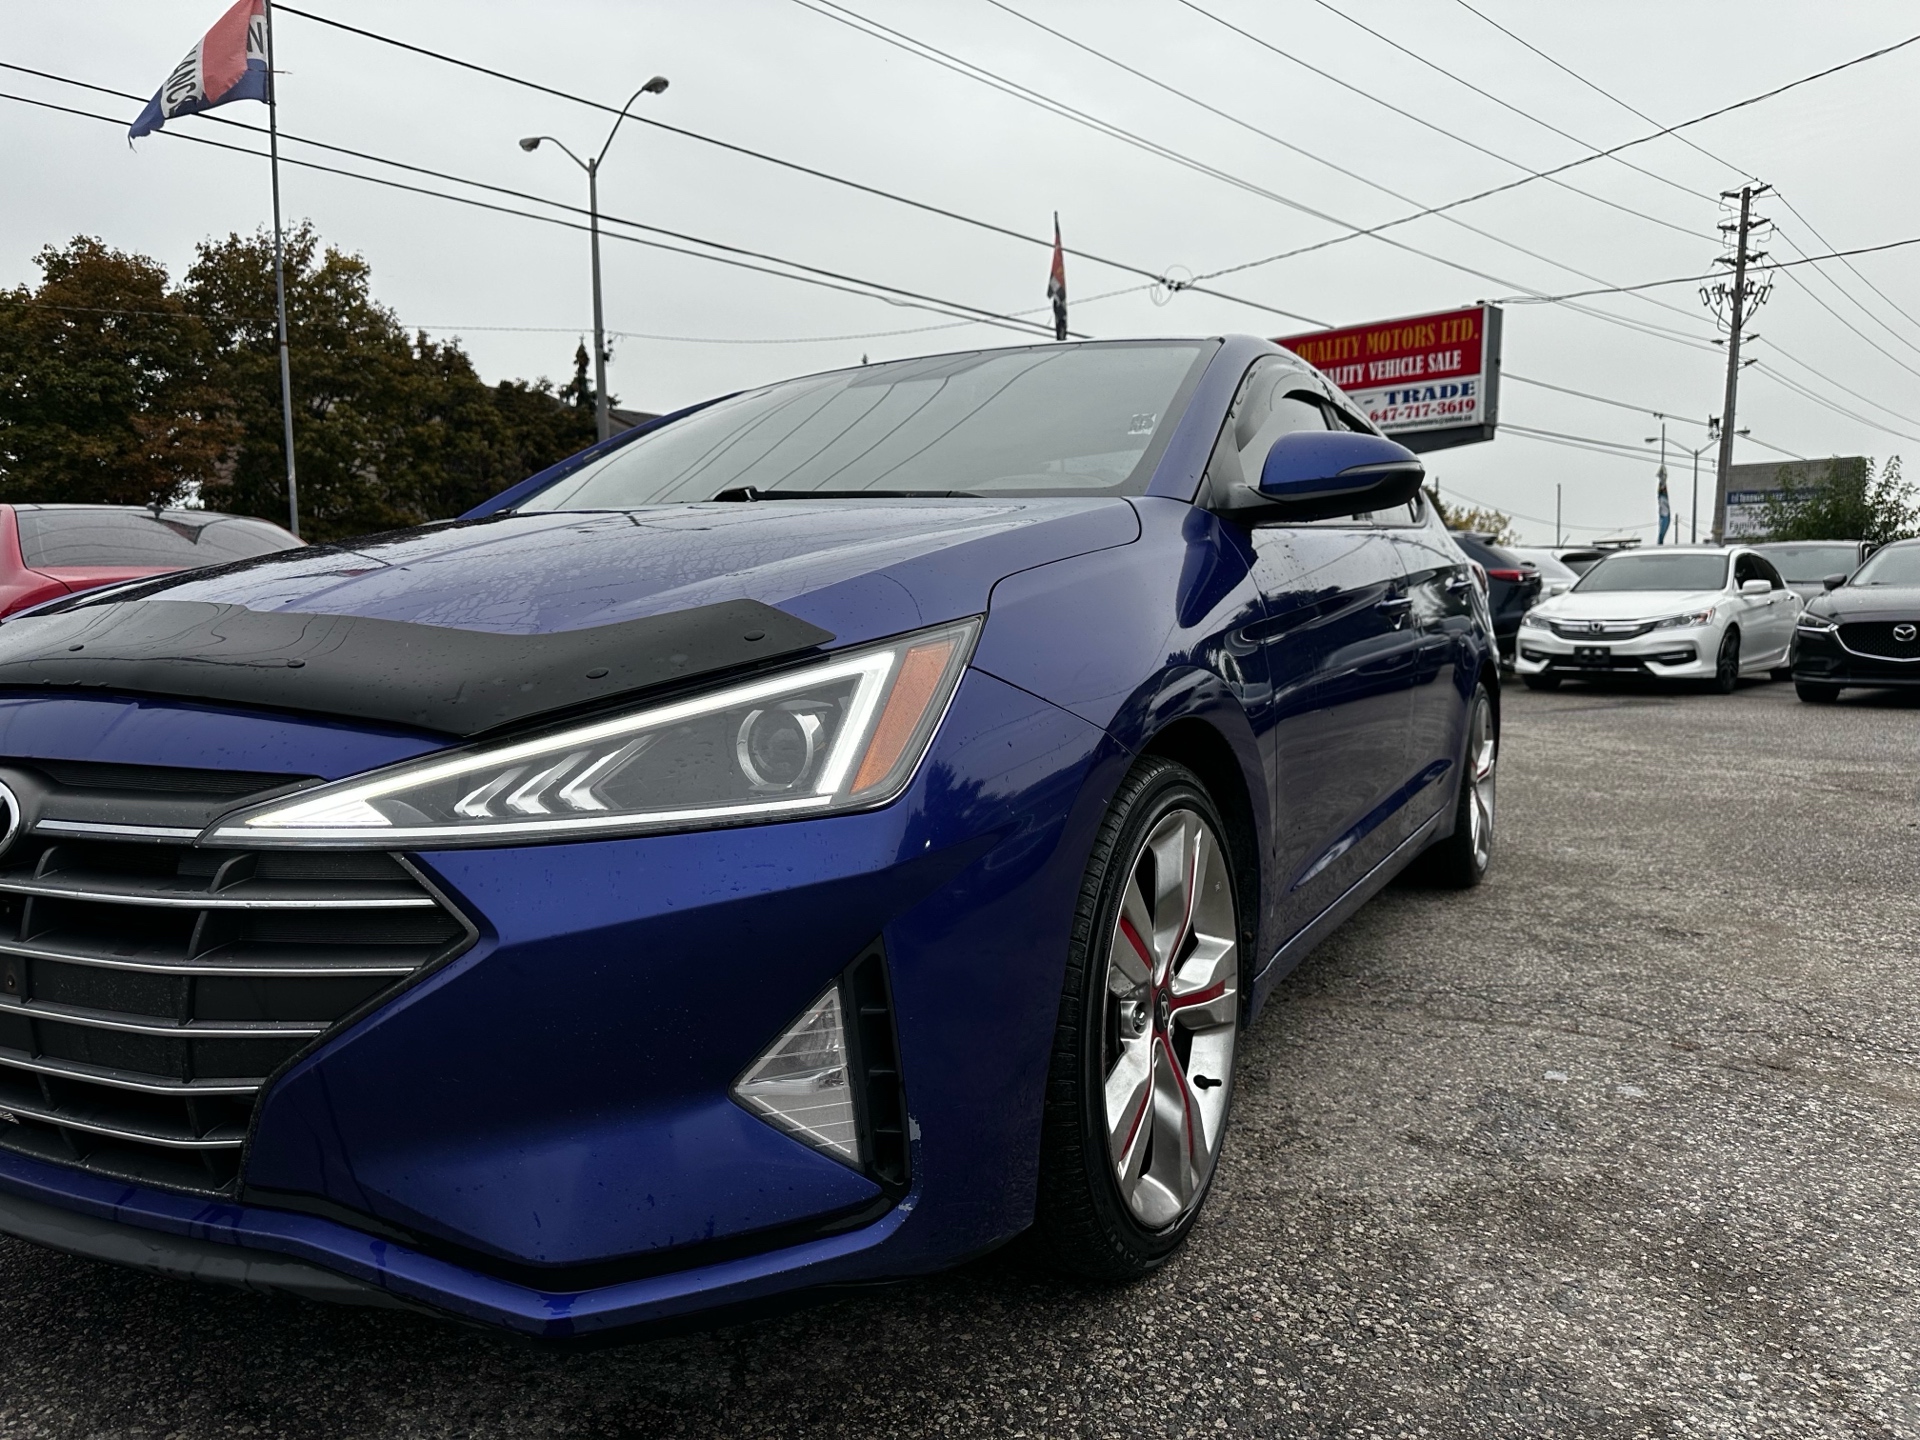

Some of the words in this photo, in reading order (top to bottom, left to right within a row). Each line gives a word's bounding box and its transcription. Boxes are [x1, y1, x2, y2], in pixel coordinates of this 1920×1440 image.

[1296, 334, 1362, 364] QUALITY
[1366, 322, 1436, 355] MOTORS
[1440, 317, 1479, 344] LTD.
[1368, 354, 1424, 382] VEHICLE
[1427, 349, 1462, 373] SALE
[1384, 380, 1476, 406] TRADE
[1369, 398, 1476, 422] 647-717-3619
